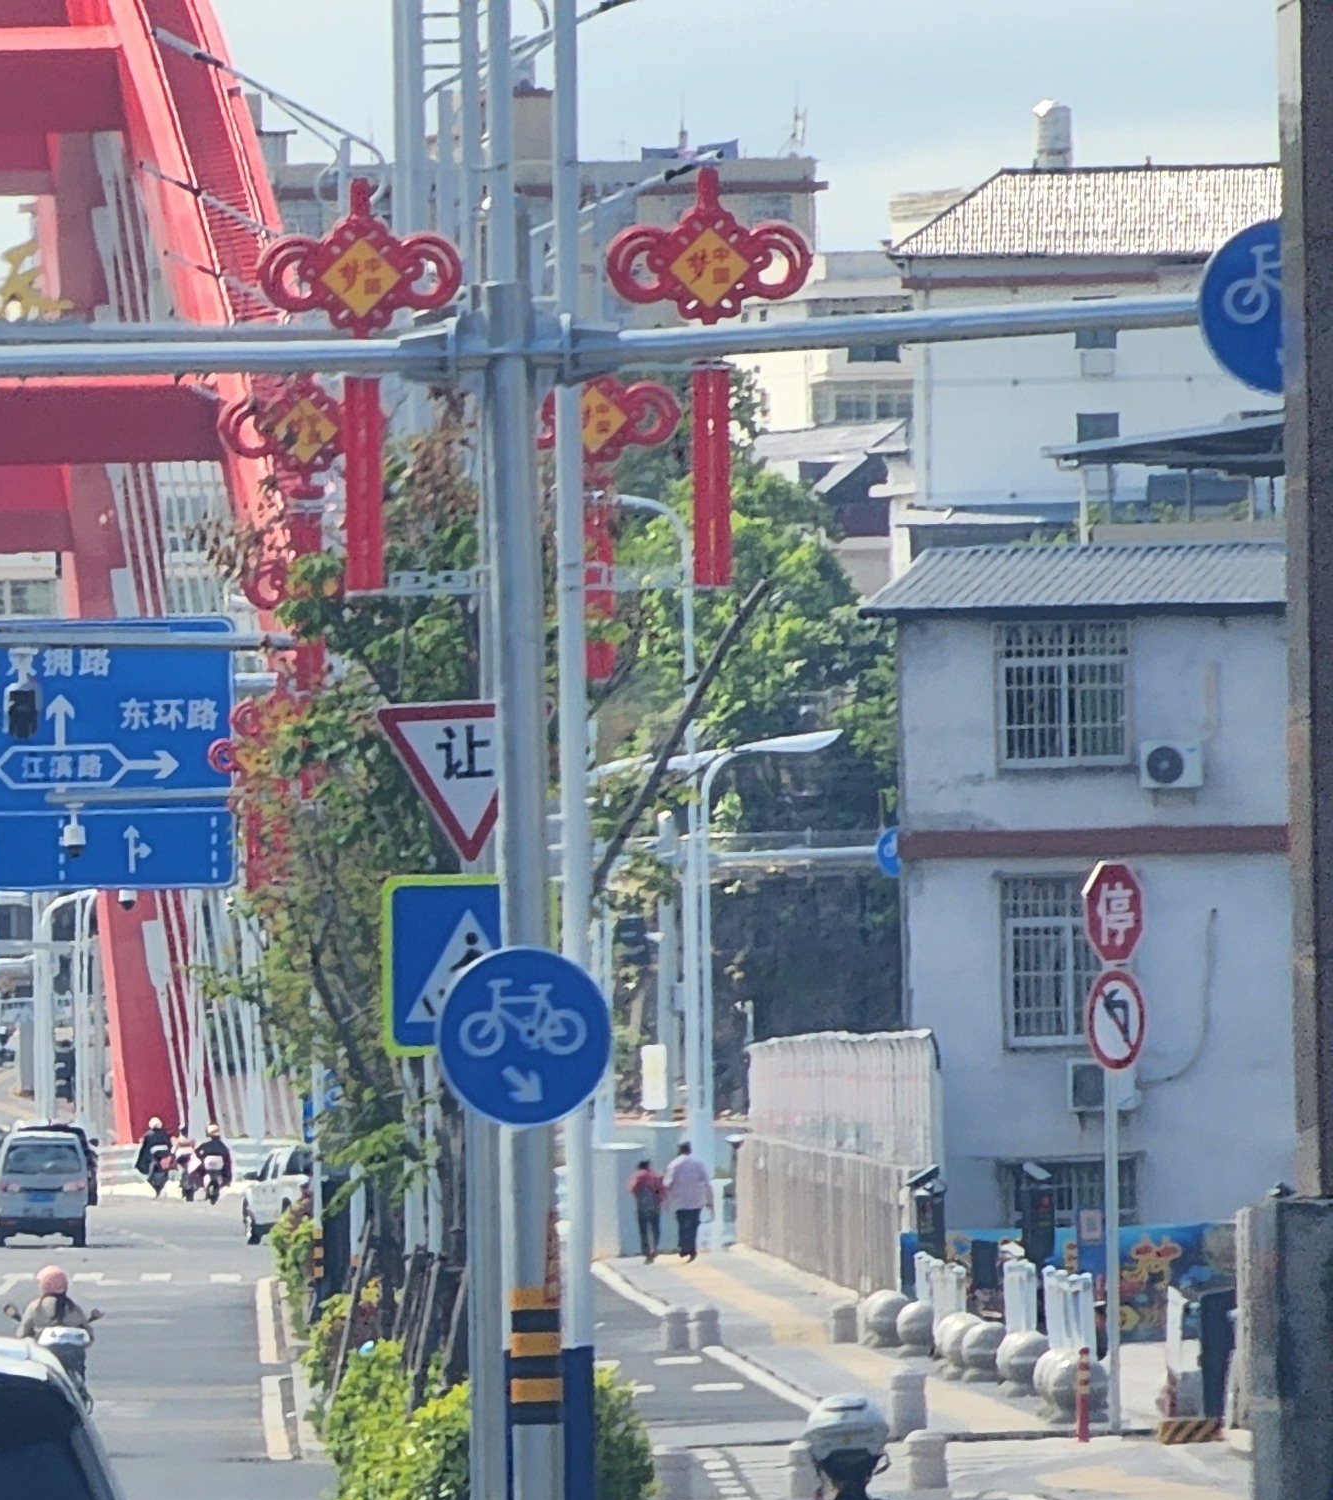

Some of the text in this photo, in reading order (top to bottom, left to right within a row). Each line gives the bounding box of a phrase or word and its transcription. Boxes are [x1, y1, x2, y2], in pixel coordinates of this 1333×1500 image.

[120, 698, 219, 732] 东环路
[436, 724, 495, 781] 让
[1097, 881, 1135, 947] 停
